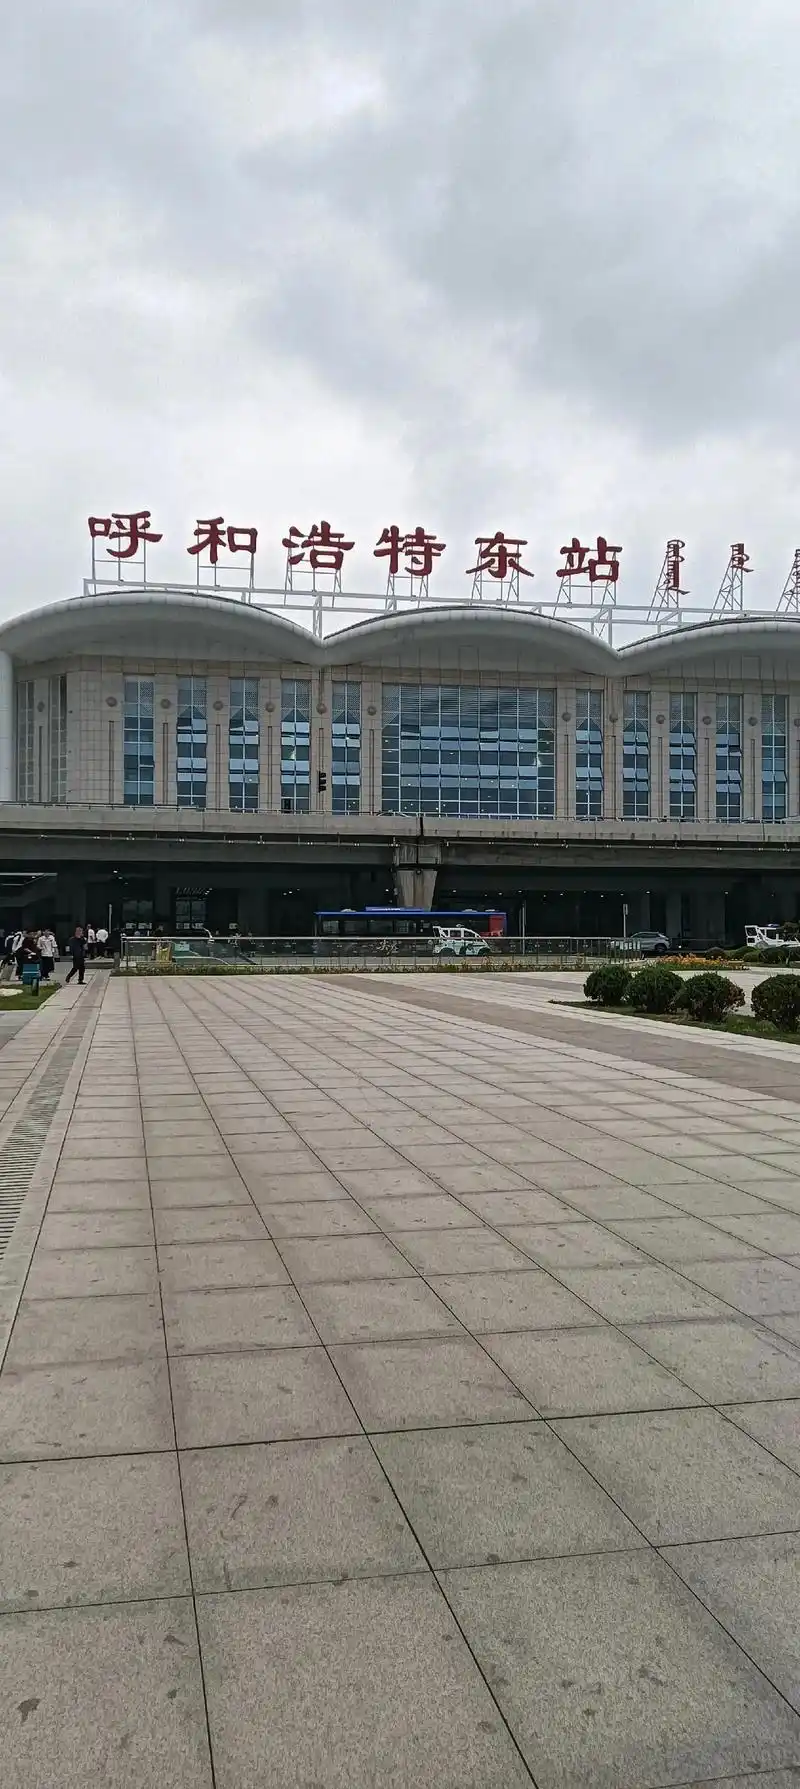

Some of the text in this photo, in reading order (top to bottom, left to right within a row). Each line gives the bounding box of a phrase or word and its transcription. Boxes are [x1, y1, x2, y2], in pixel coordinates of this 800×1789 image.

[88, 510, 622, 584] 呼和浩特东站
